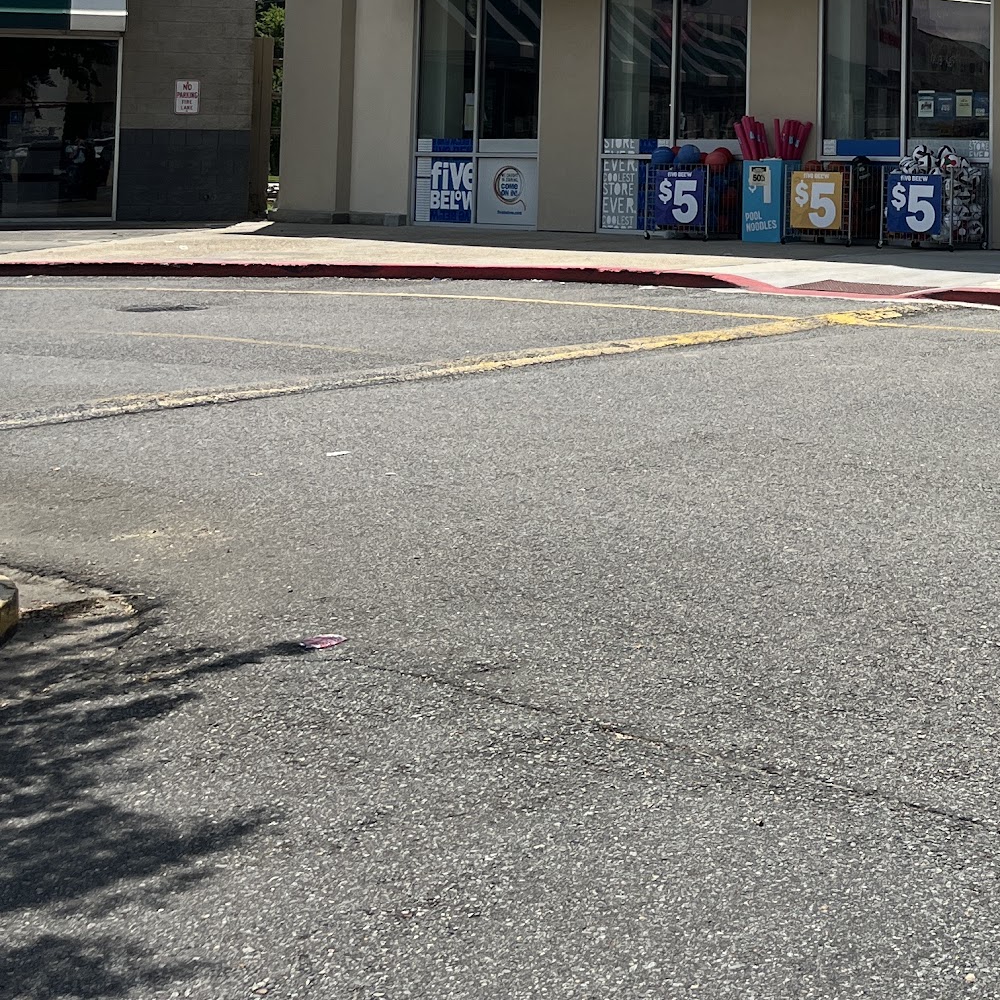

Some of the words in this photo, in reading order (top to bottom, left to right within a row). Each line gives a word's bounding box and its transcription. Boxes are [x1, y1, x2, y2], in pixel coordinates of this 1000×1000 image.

[604, 139, 635, 149] STORE
[431, 161, 474, 191] five
[603, 172, 635, 183] COOLEST
[603, 182, 634, 196] STORE
[602, 197, 637, 214] EVER.
[658, 178, 699, 224] $5
[794, 180, 836, 229] $5
[891, 182, 936, 233] $5
[745, 211, 763, 222] POOL
[745, 220, 778, 233] NOODLES
